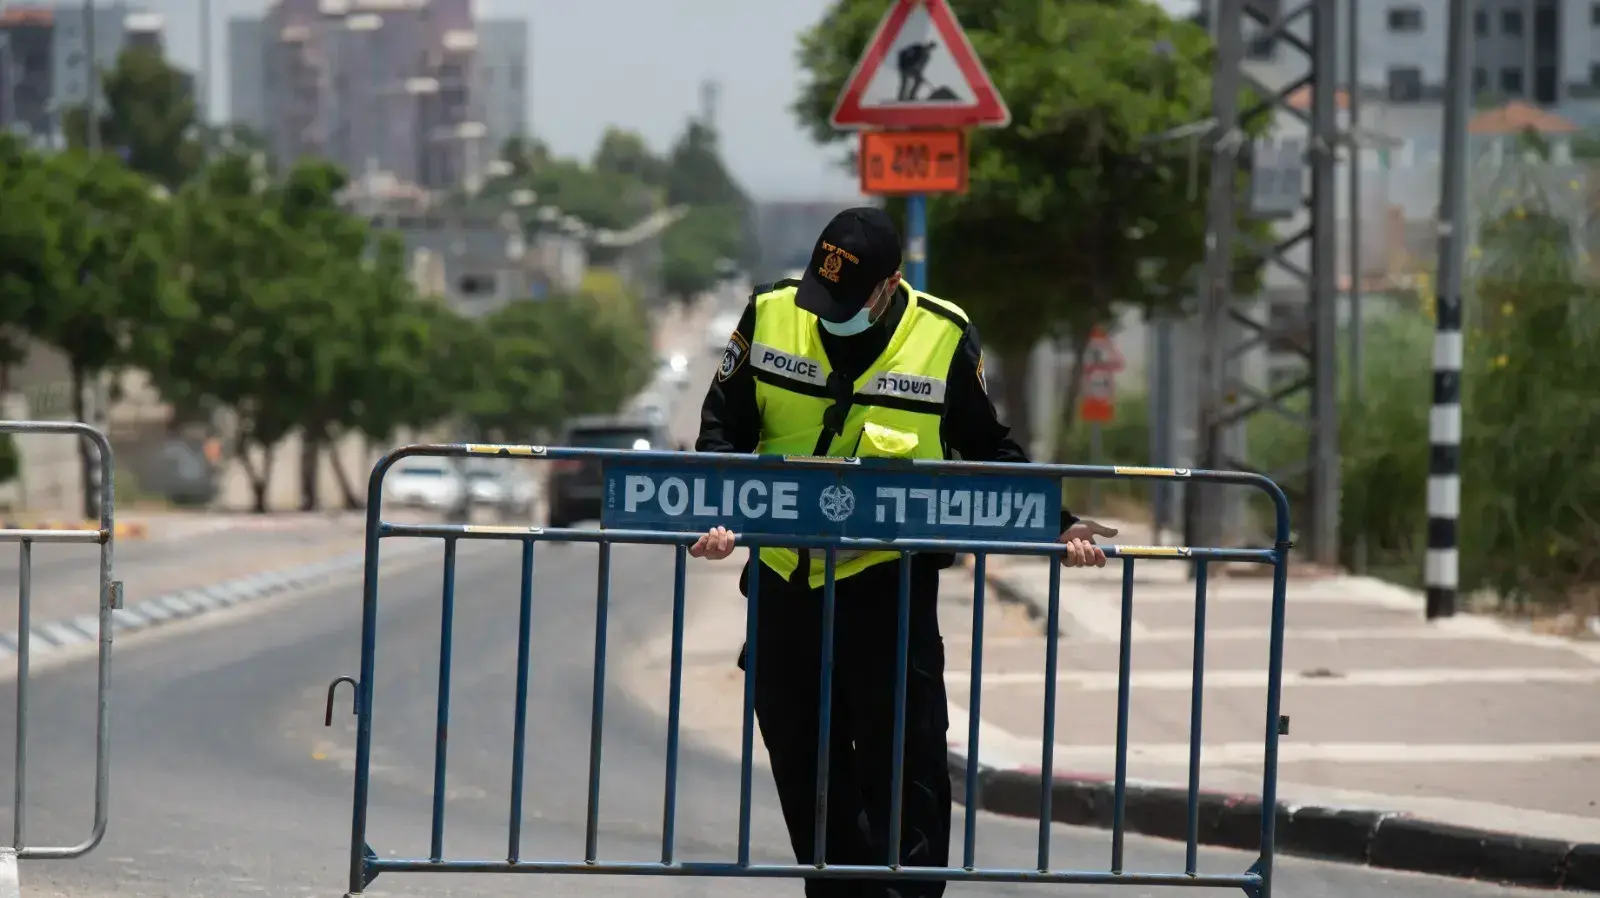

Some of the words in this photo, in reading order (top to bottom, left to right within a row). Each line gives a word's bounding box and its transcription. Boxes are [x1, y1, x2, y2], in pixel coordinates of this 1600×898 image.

[893, 145, 929, 178] 400
[819, 267, 840, 282] POLICE
[762, 351, 817, 378] POLICE
[877, 377, 931, 395] משטרה
[624, 475, 799, 520] POLICE
[875, 486, 1046, 528] משטרה
